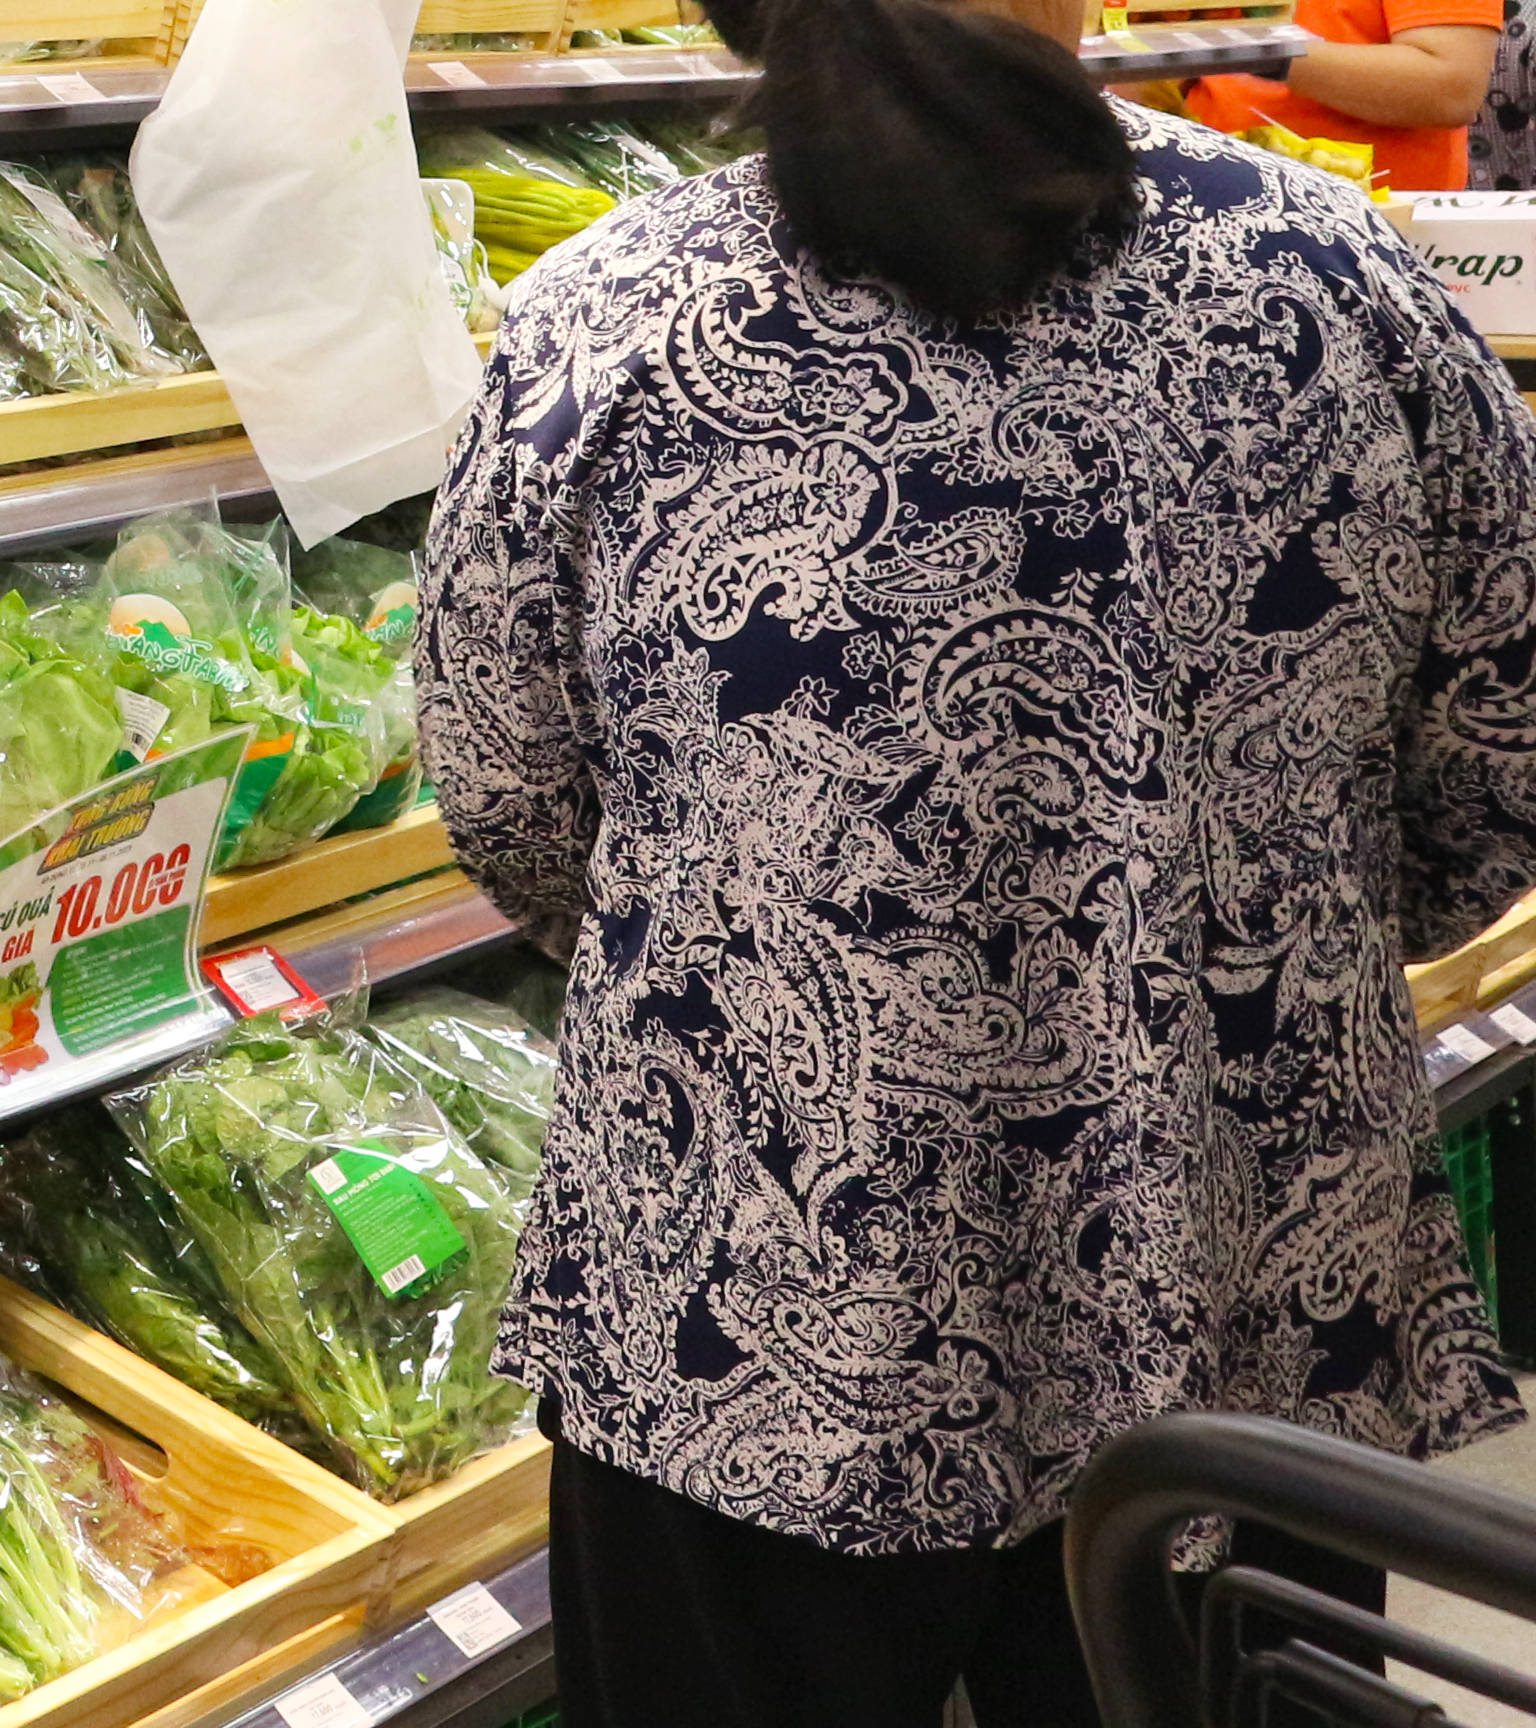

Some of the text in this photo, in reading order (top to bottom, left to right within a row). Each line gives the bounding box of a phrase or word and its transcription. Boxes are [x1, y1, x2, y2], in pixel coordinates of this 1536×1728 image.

[1415, 244, 1524, 286] rap
[16, 885, 56, 929] QUẢ
[2, 924, 37, 964] GIÁ
